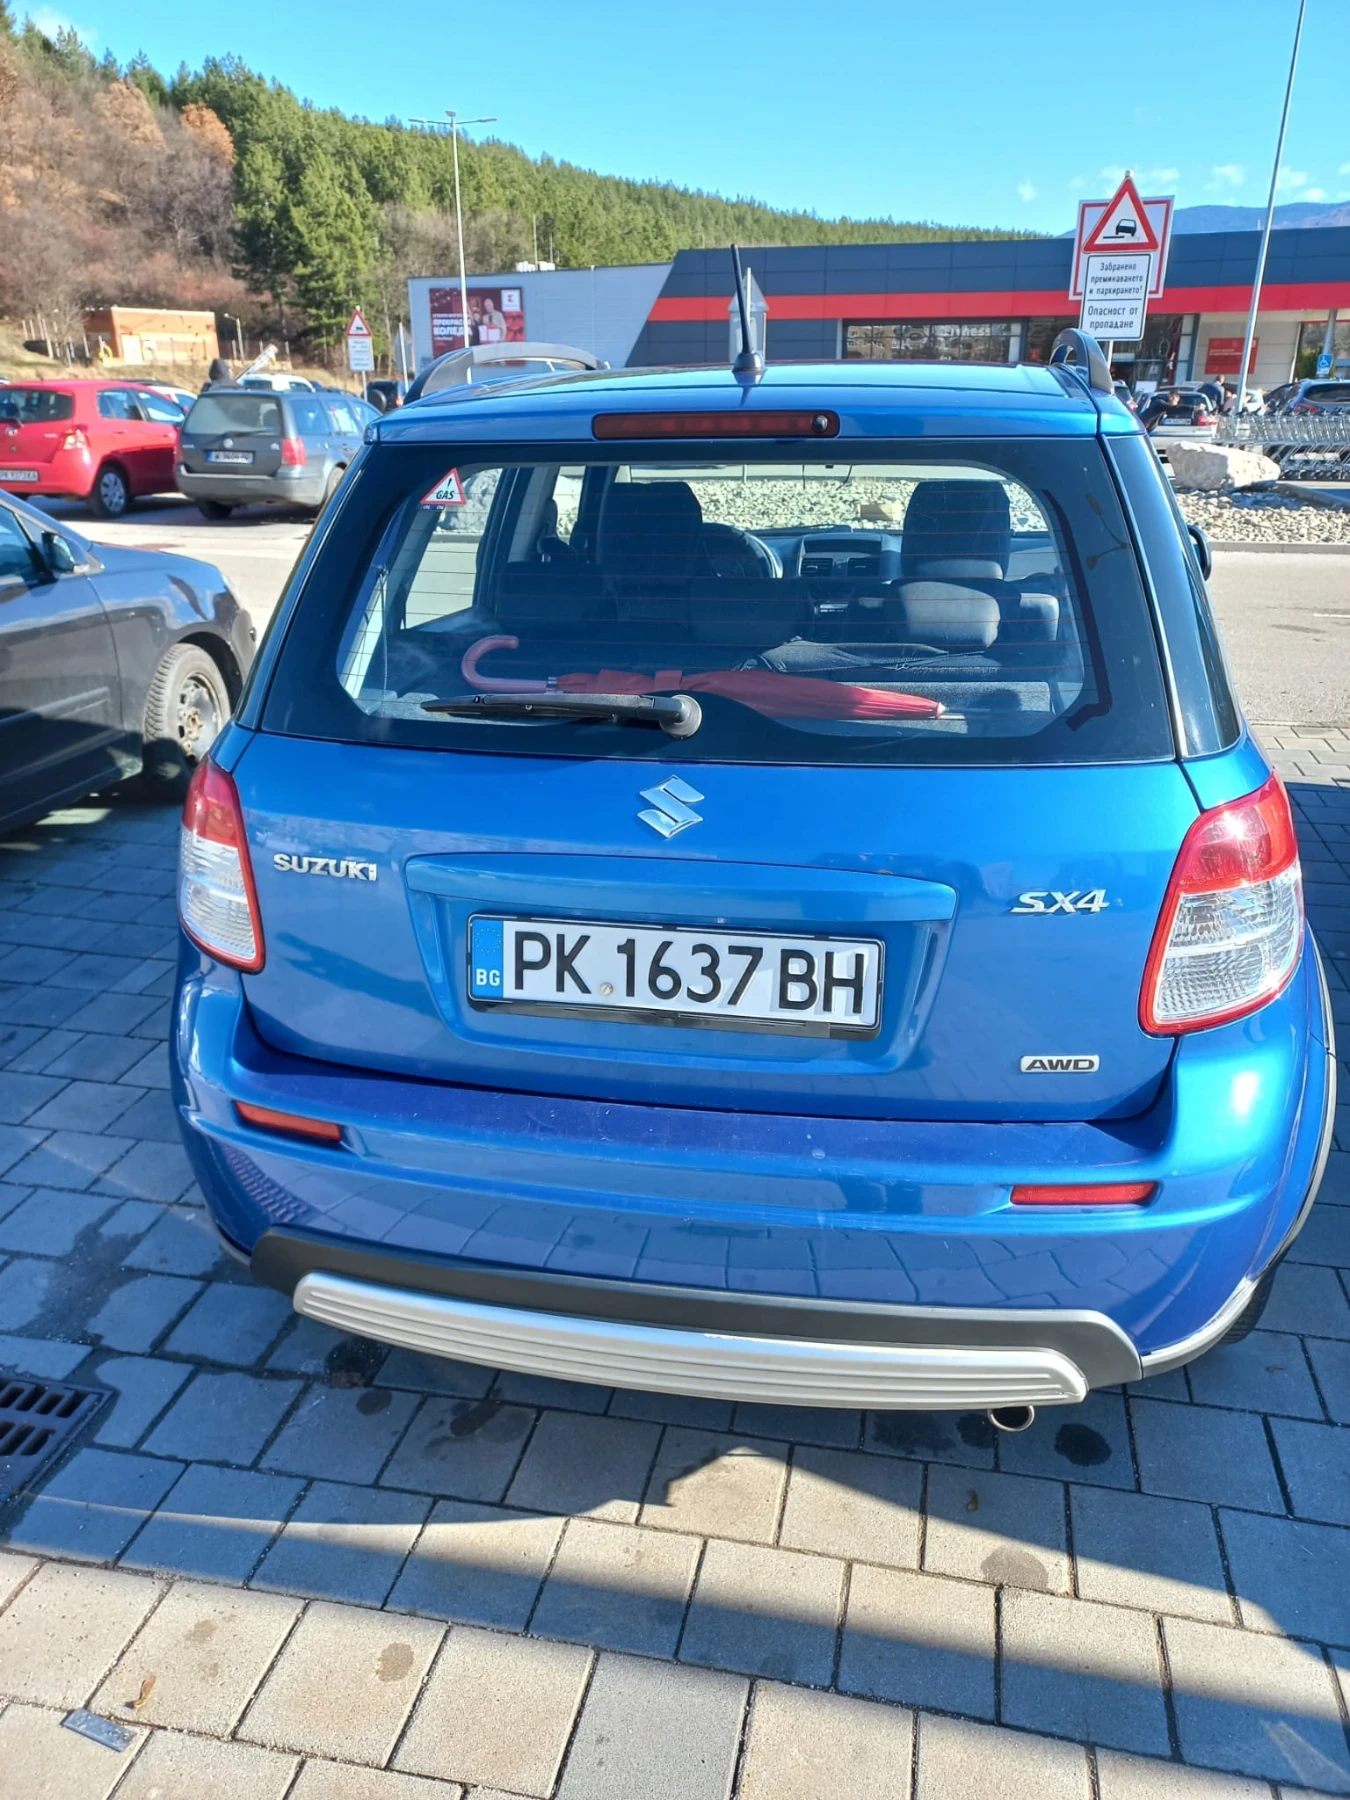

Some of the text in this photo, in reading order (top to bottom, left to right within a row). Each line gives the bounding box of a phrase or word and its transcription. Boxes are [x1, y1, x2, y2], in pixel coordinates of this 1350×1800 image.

[1100, 262, 1137, 272] Забранено
[1091, 275, 1143, 284] преминаването
[1096, 285, 1143, 296] паркирането!
[1087, 305, 1138, 316] Опасност от
[1089, 320, 1133, 330] пропадане
[436, 490, 455, 500] GAS
[273, 853, 377, 881] SUZUKI
[1010, 889, 1110, 913] SX4
[476, 968, 501, 987] BG
[513, 930, 865, 1014] PK 1637 BH
[1025, 1059, 1095, 1071] AWD
